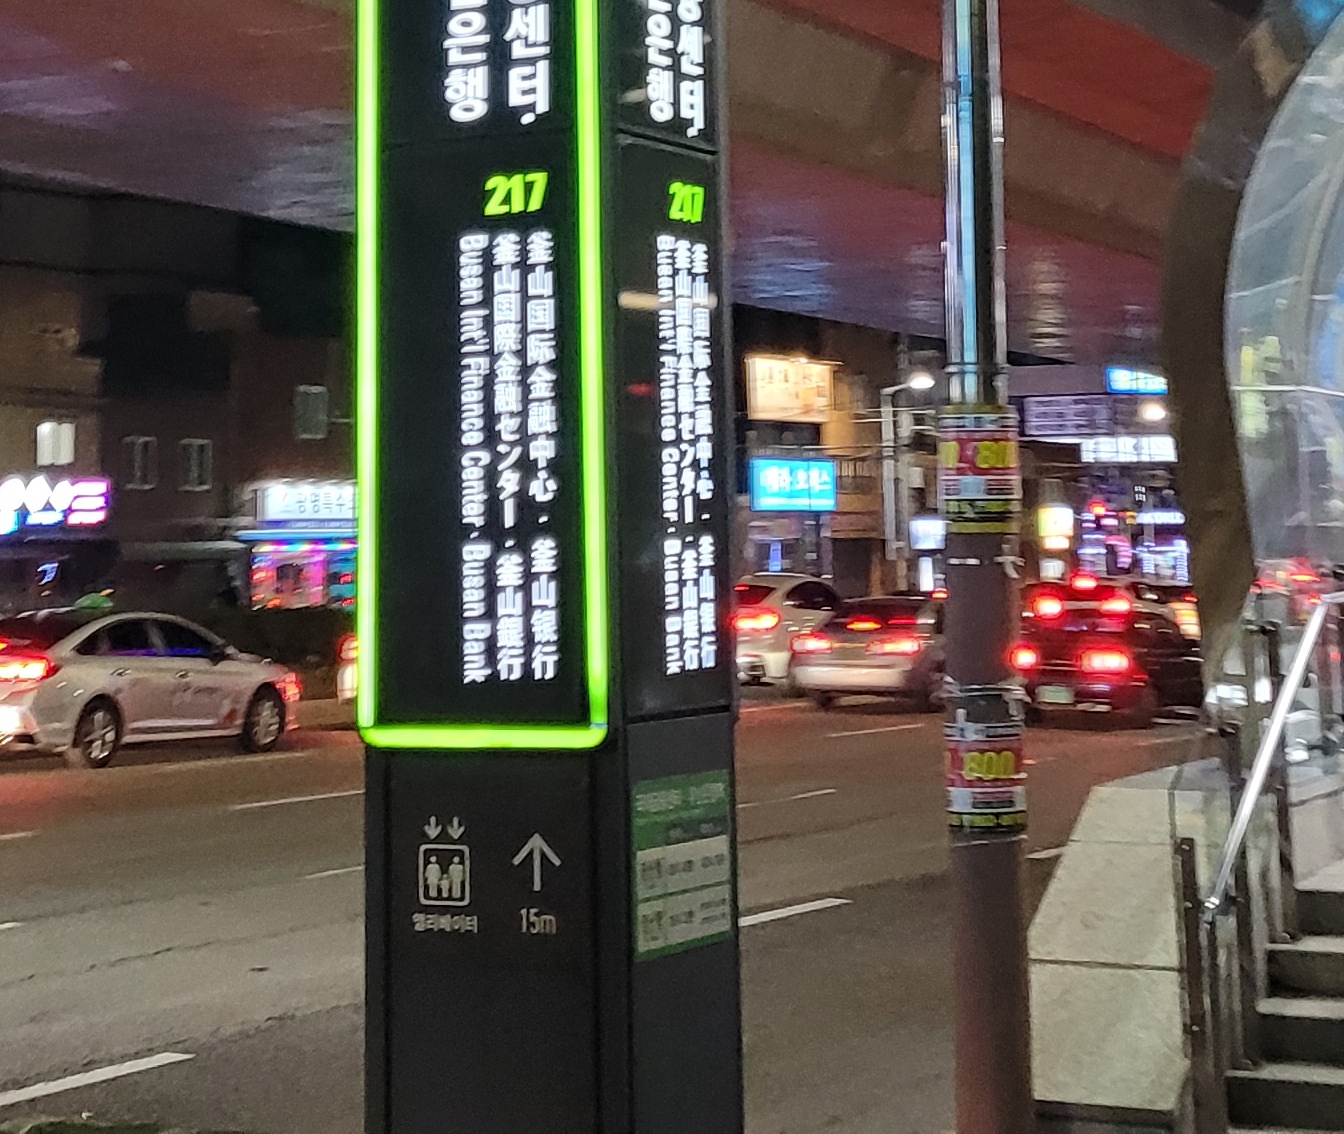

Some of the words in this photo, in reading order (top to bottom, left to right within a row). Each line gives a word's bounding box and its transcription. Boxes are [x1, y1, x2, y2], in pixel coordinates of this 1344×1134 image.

[484, 171, 549, 216] 217
[668, 181, 705, 224] 217
[459, 233, 490, 306] Busan
[459, 309, 491, 354] Int'l
[460, 356, 492, 446] Finance
[462, 543, 492, 618] Busan
[463, 622, 493, 685] Bank
[519, 907, 557, 935] 15m
